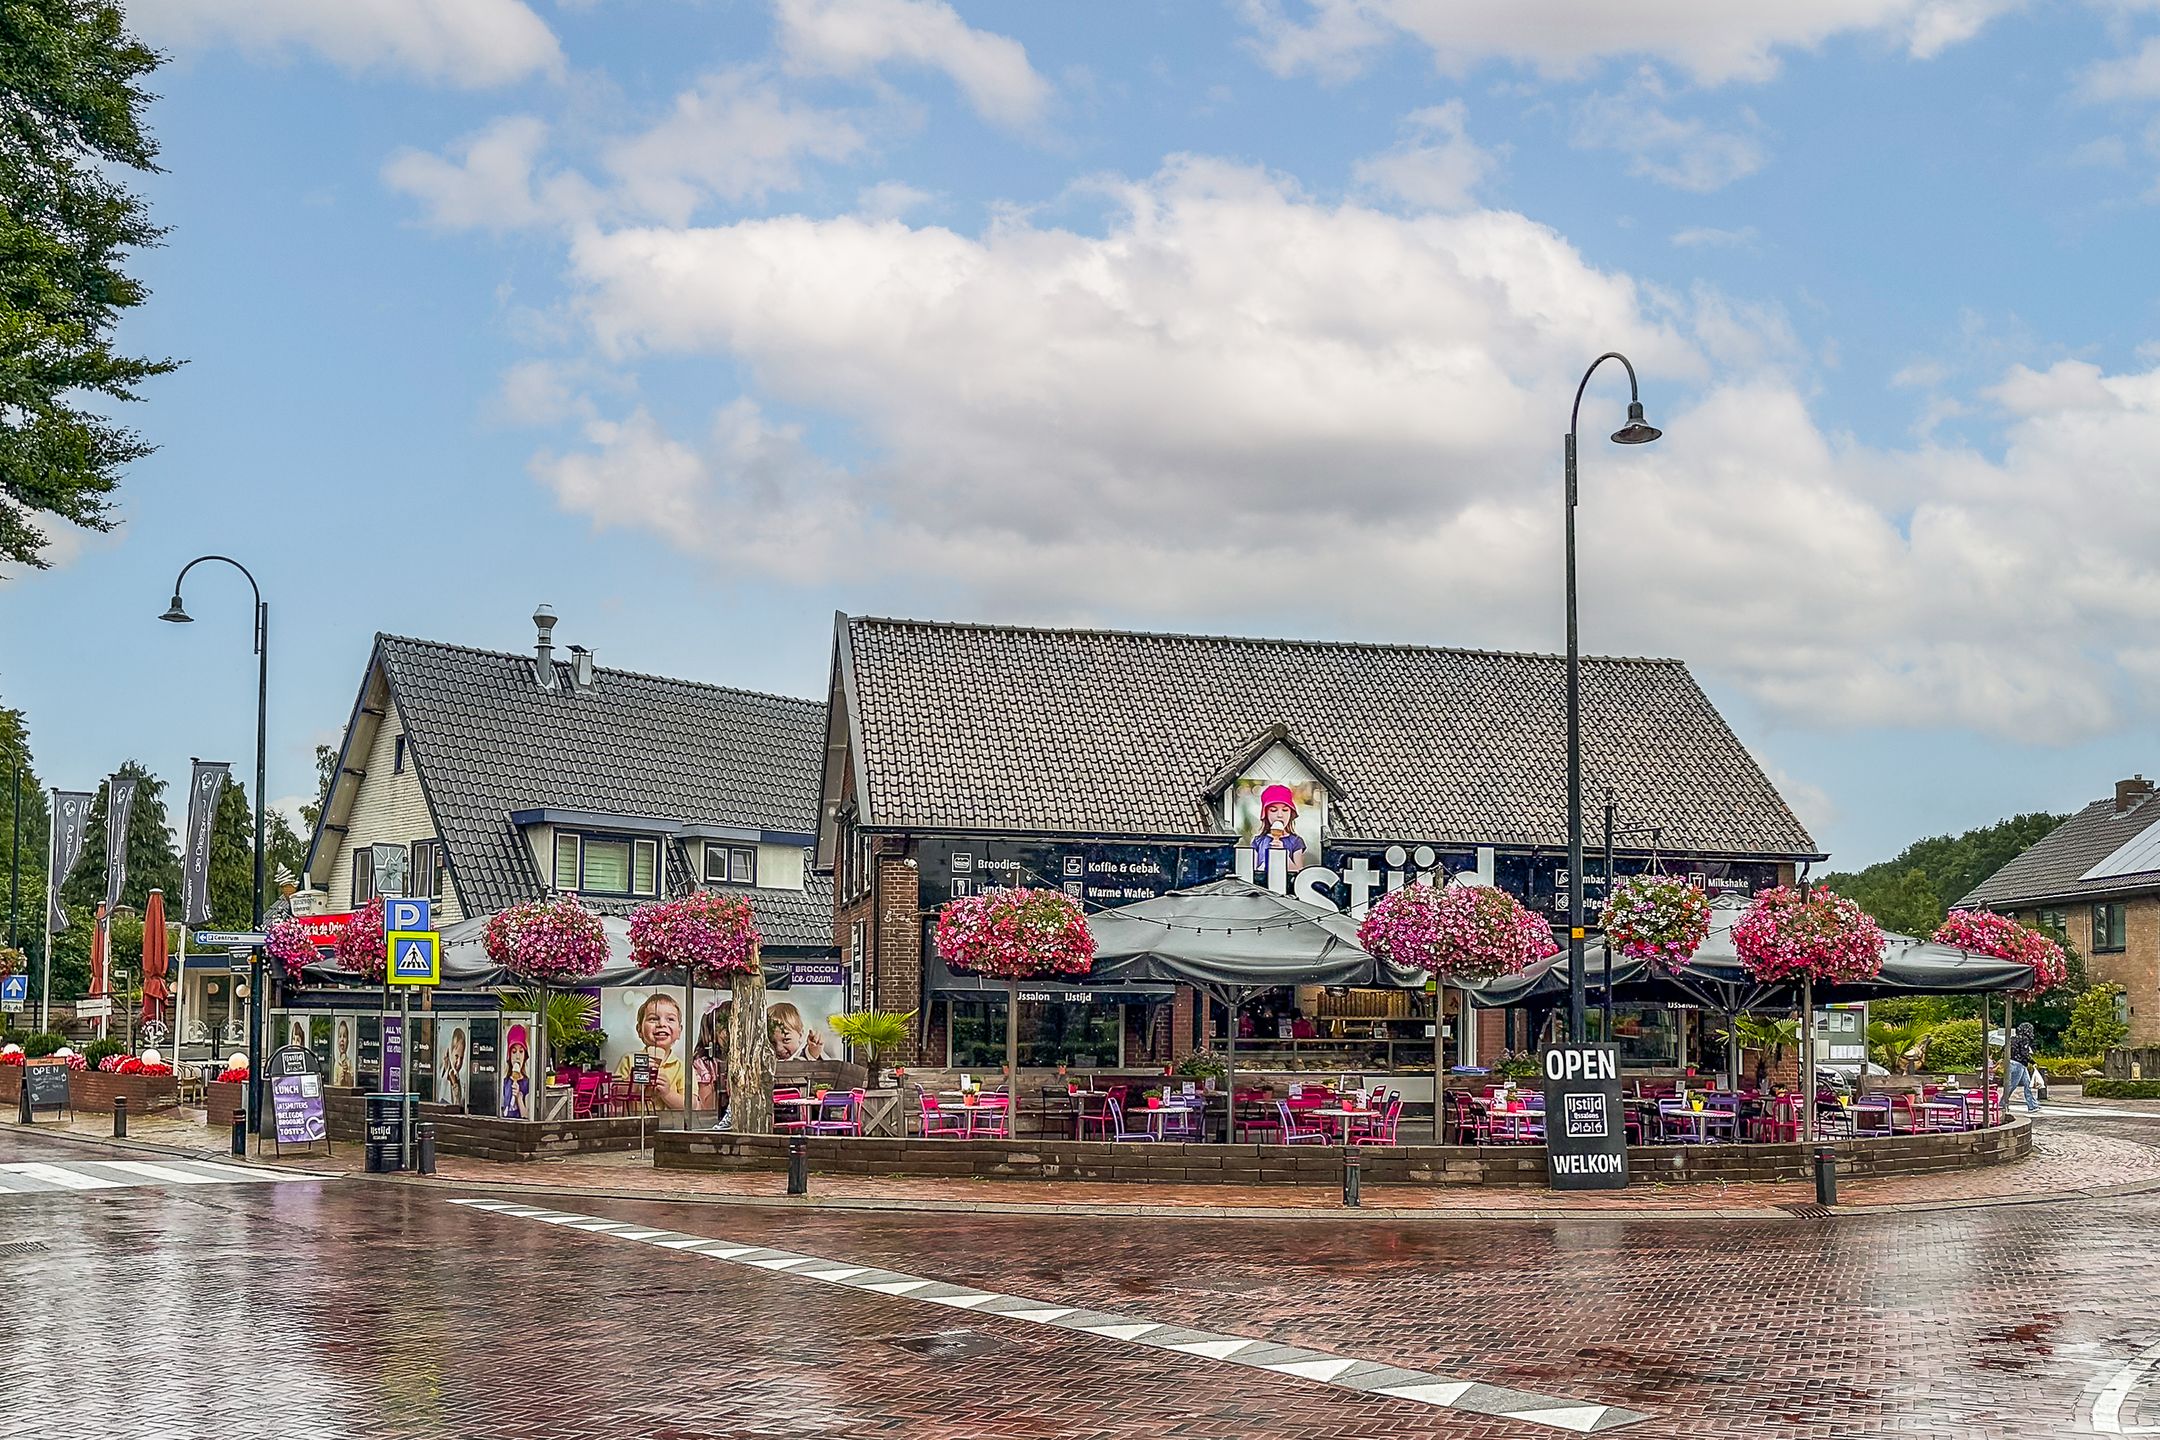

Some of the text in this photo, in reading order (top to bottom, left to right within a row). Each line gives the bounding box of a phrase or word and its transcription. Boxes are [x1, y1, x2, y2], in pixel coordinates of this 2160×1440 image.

[977, 859, 1021, 870] Broodjes
[1088, 862, 1160, 874] Koffie & Gebak
[1707, 878, 1748, 888] Milkshake
[1088, 886, 1155, 899] Warme Wafels
[394, 903, 421, 931] P
[795, 965, 839, 973] BROCCOLI
[791, 973, 834, 983] ice cream
[1017, 991, 1050, 1001] Jssalon
[1546, 1049, 1617, 1080] OPEN
[32, 1066, 59, 1076] OPEN
[274, 1085, 299, 1095] LUNCH
[1552, 1154, 1623, 1174] WELKOM
